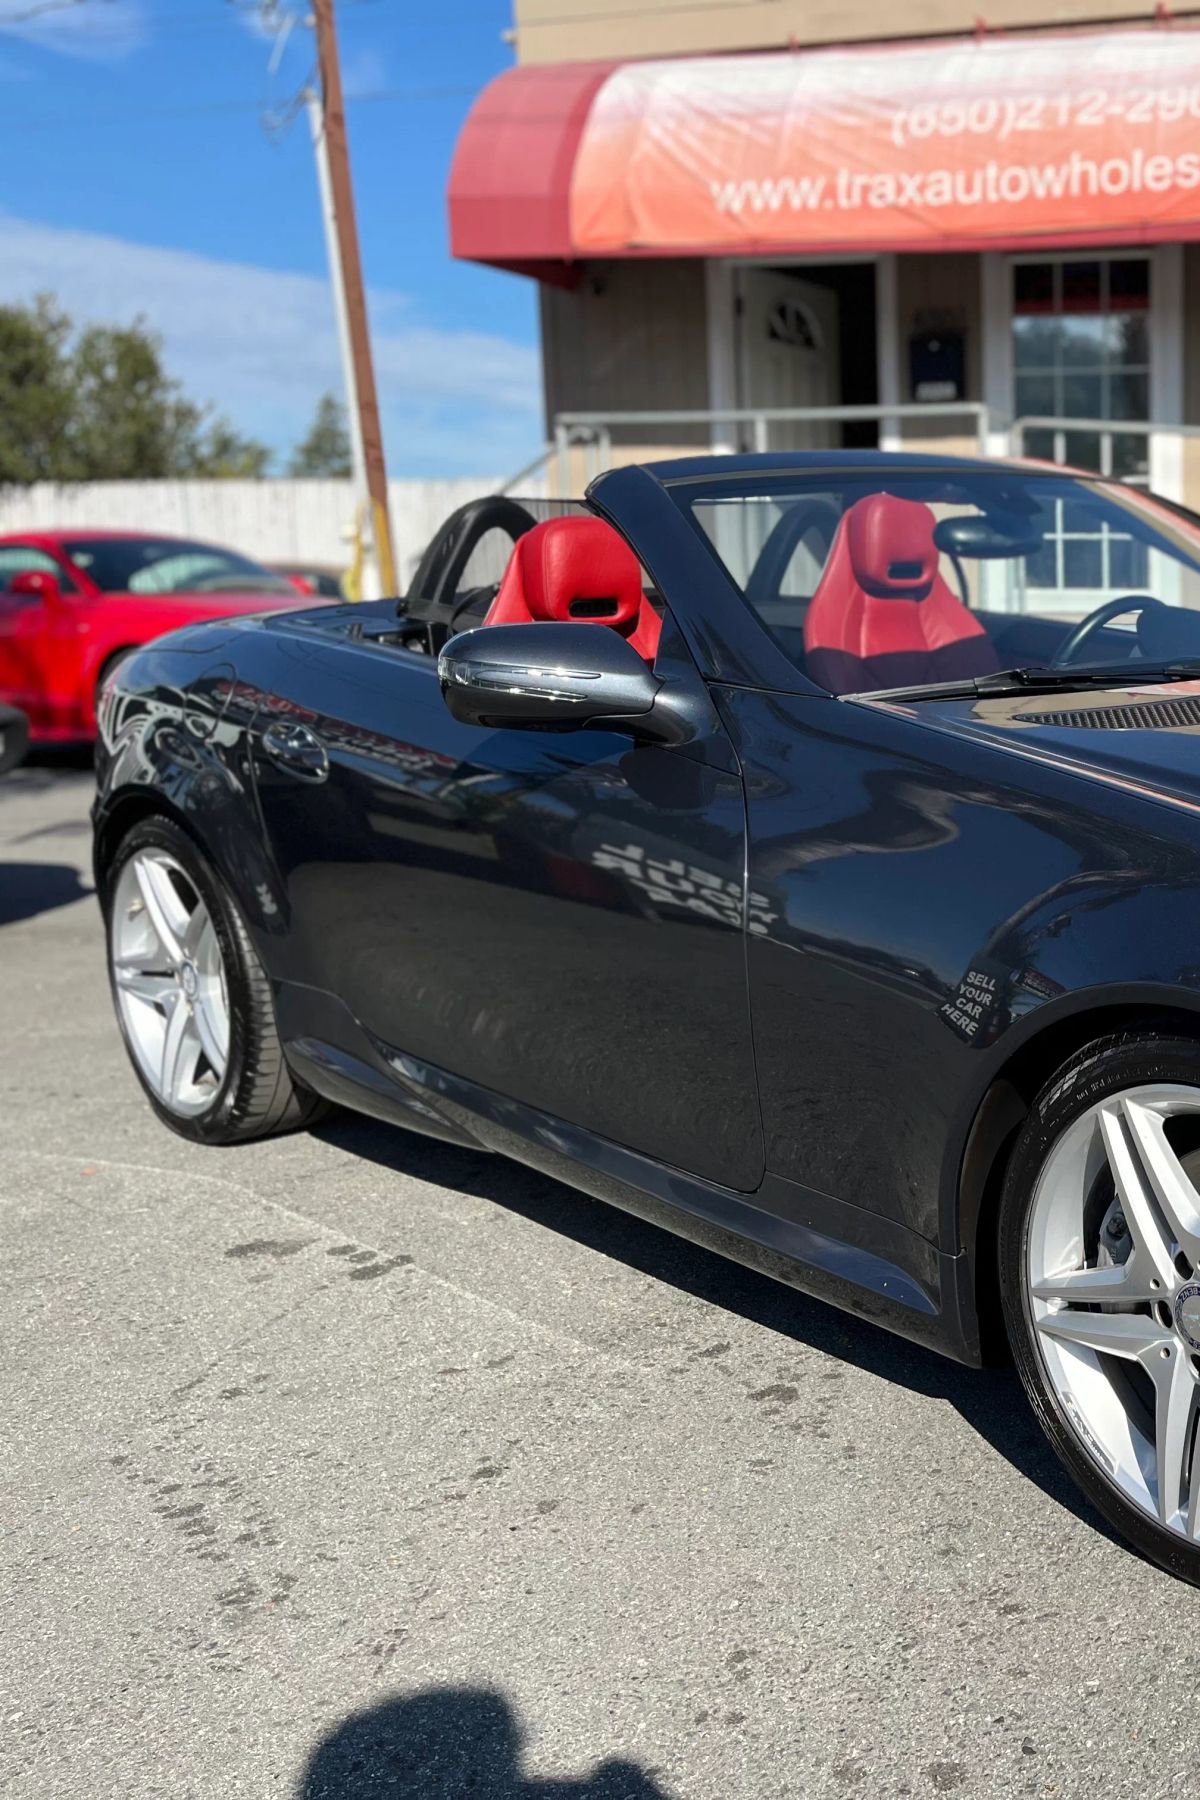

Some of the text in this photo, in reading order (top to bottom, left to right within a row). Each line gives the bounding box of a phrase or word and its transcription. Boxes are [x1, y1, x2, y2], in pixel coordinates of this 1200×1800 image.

[966, 971, 996, 991] SELL
[960, 983, 993, 1006] YOUR
[955, 997, 983, 1019] CAR
[941, 1003, 979, 1036] HERE
